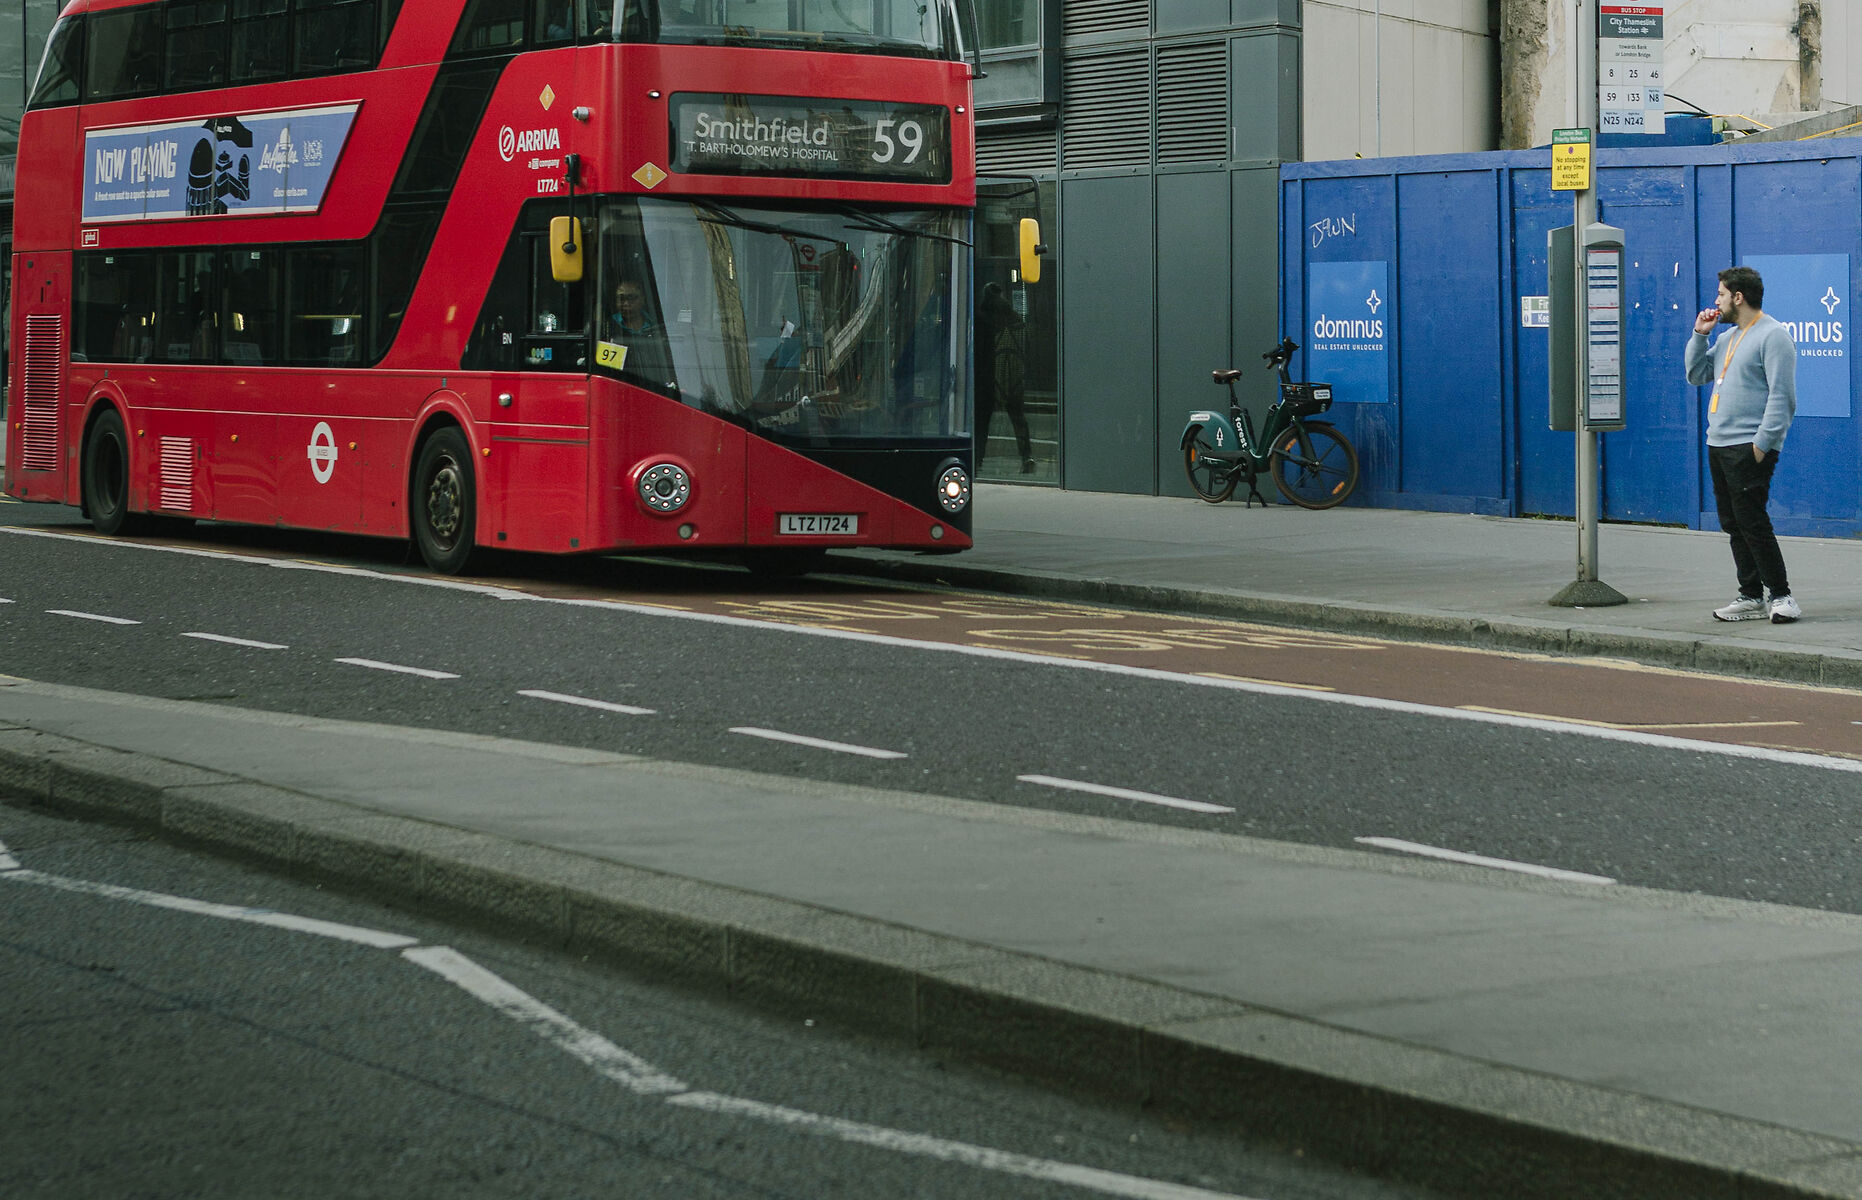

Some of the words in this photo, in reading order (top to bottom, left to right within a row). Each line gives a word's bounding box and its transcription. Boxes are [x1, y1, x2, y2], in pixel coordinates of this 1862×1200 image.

[1610, 18, 1622, 26] City
[1609, 68, 1614, 78] 8
[1629, 70, 1638, 78] 25
[1650, 70, 1659, 78] 46
[1607, 93, 1617, 101] 59
[1628, 93, 1640, 102] 133
[1649, 94, 1660, 102] N8
[1604, 116, 1620, 125] N25
[1624, 117, 1644, 125] N242
[695, 112, 828, 146] Smithfield
[516, 128, 560, 152] ARRIVA
[871, 120, 922, 164] 59
[700, 142, 789, 158] BARTHOLOMEW'S
[792, 149, 839, 161] HOSPITAL
[95, 148, 126, 184] NOW
[130, 140, 178, 184] PLAYING
[537, 179, 558, 192] LT724
[1539, 300, 1549, 310] Fir
[1538, 313, 1549, 323] Kee
[1314, 314, 1383, 338] dominus
[1781, 322, 1843, 342] minus
[502, 332, 512, 345] BN
[602, 349, 618, 362] 97
[1235, 416, 1248, 448] forest
